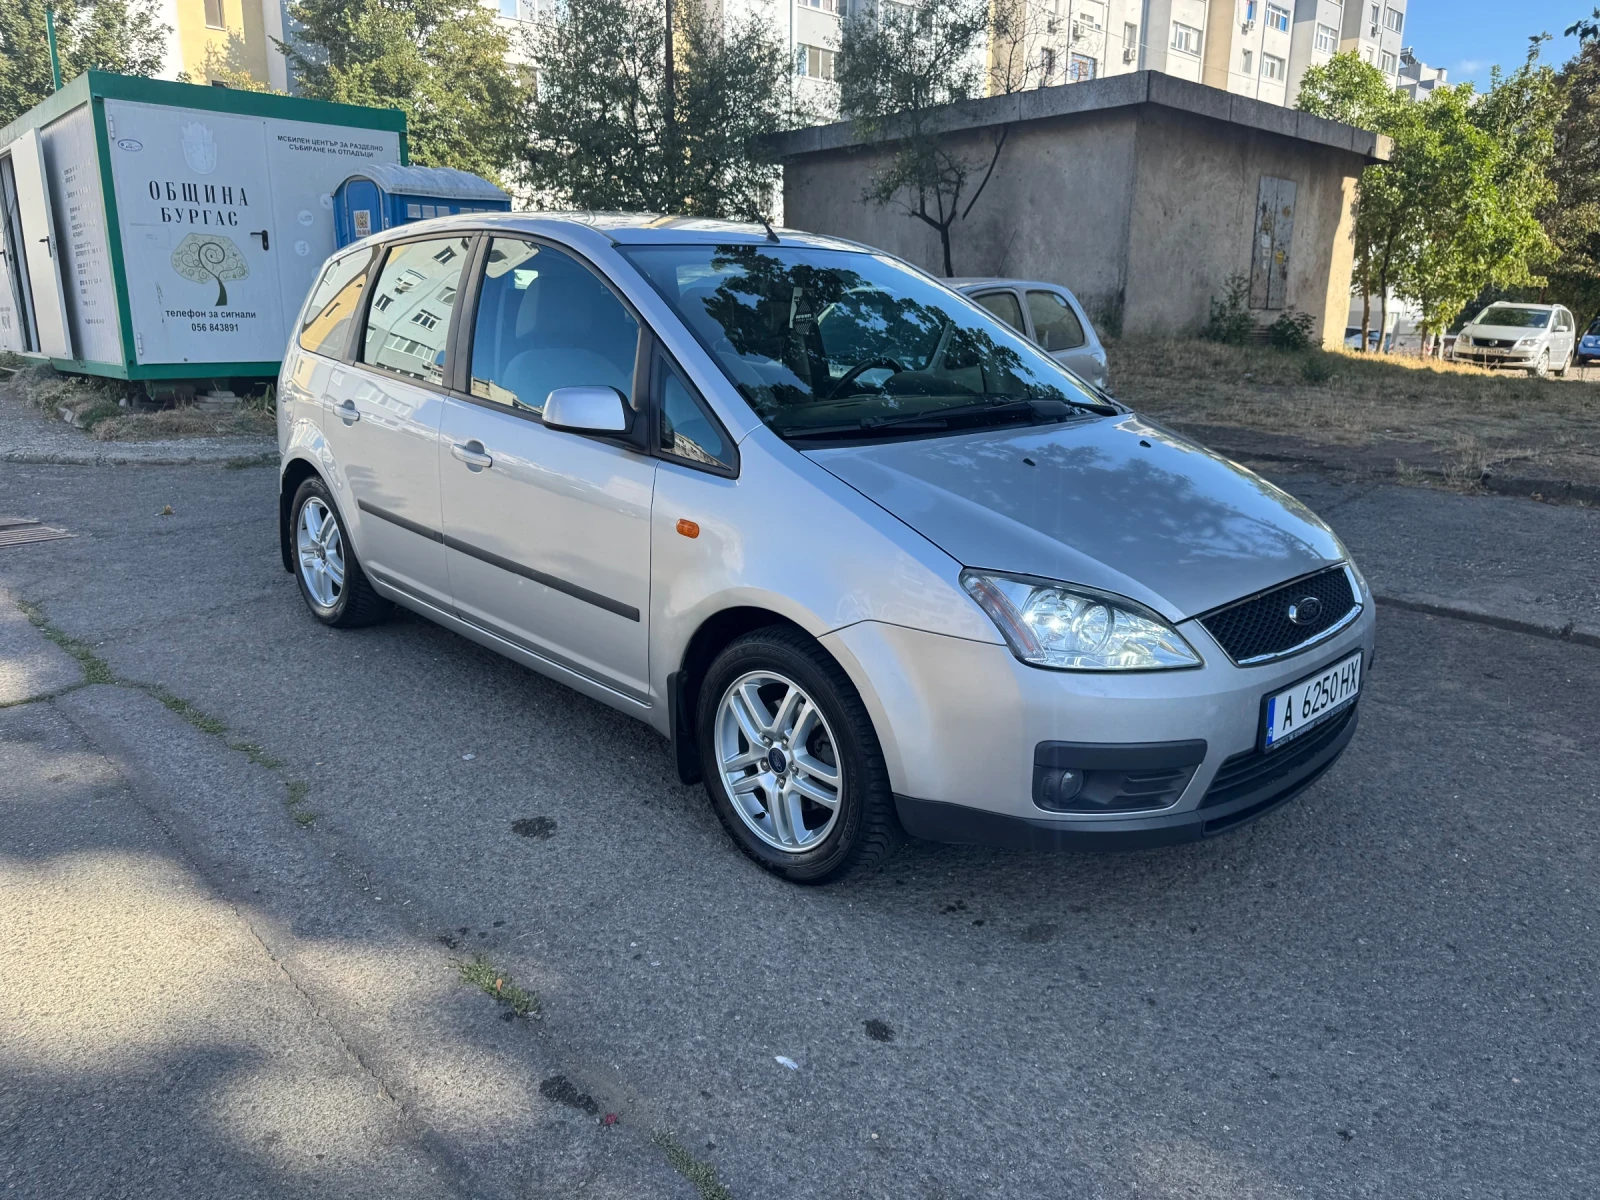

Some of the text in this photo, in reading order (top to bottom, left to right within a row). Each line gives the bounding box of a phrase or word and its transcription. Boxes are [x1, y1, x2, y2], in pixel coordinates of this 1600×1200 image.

[289, 143, 373, 158] СЪБИРАНЕ НА ОТПАДЪЦИ
[311, 139, 338, 147] ЦЕНТЪР
[350, 142, 383, 152] РАЗДЕЛНО
[149, 180, 249, 206] ОБЩИНА
[160, 207, 238, 226] БУРГАС
[165, 308, 206, 319] телефон
[220, 311, 256, 319] сигнали
[191, 322, 239, 332] 056 843891
